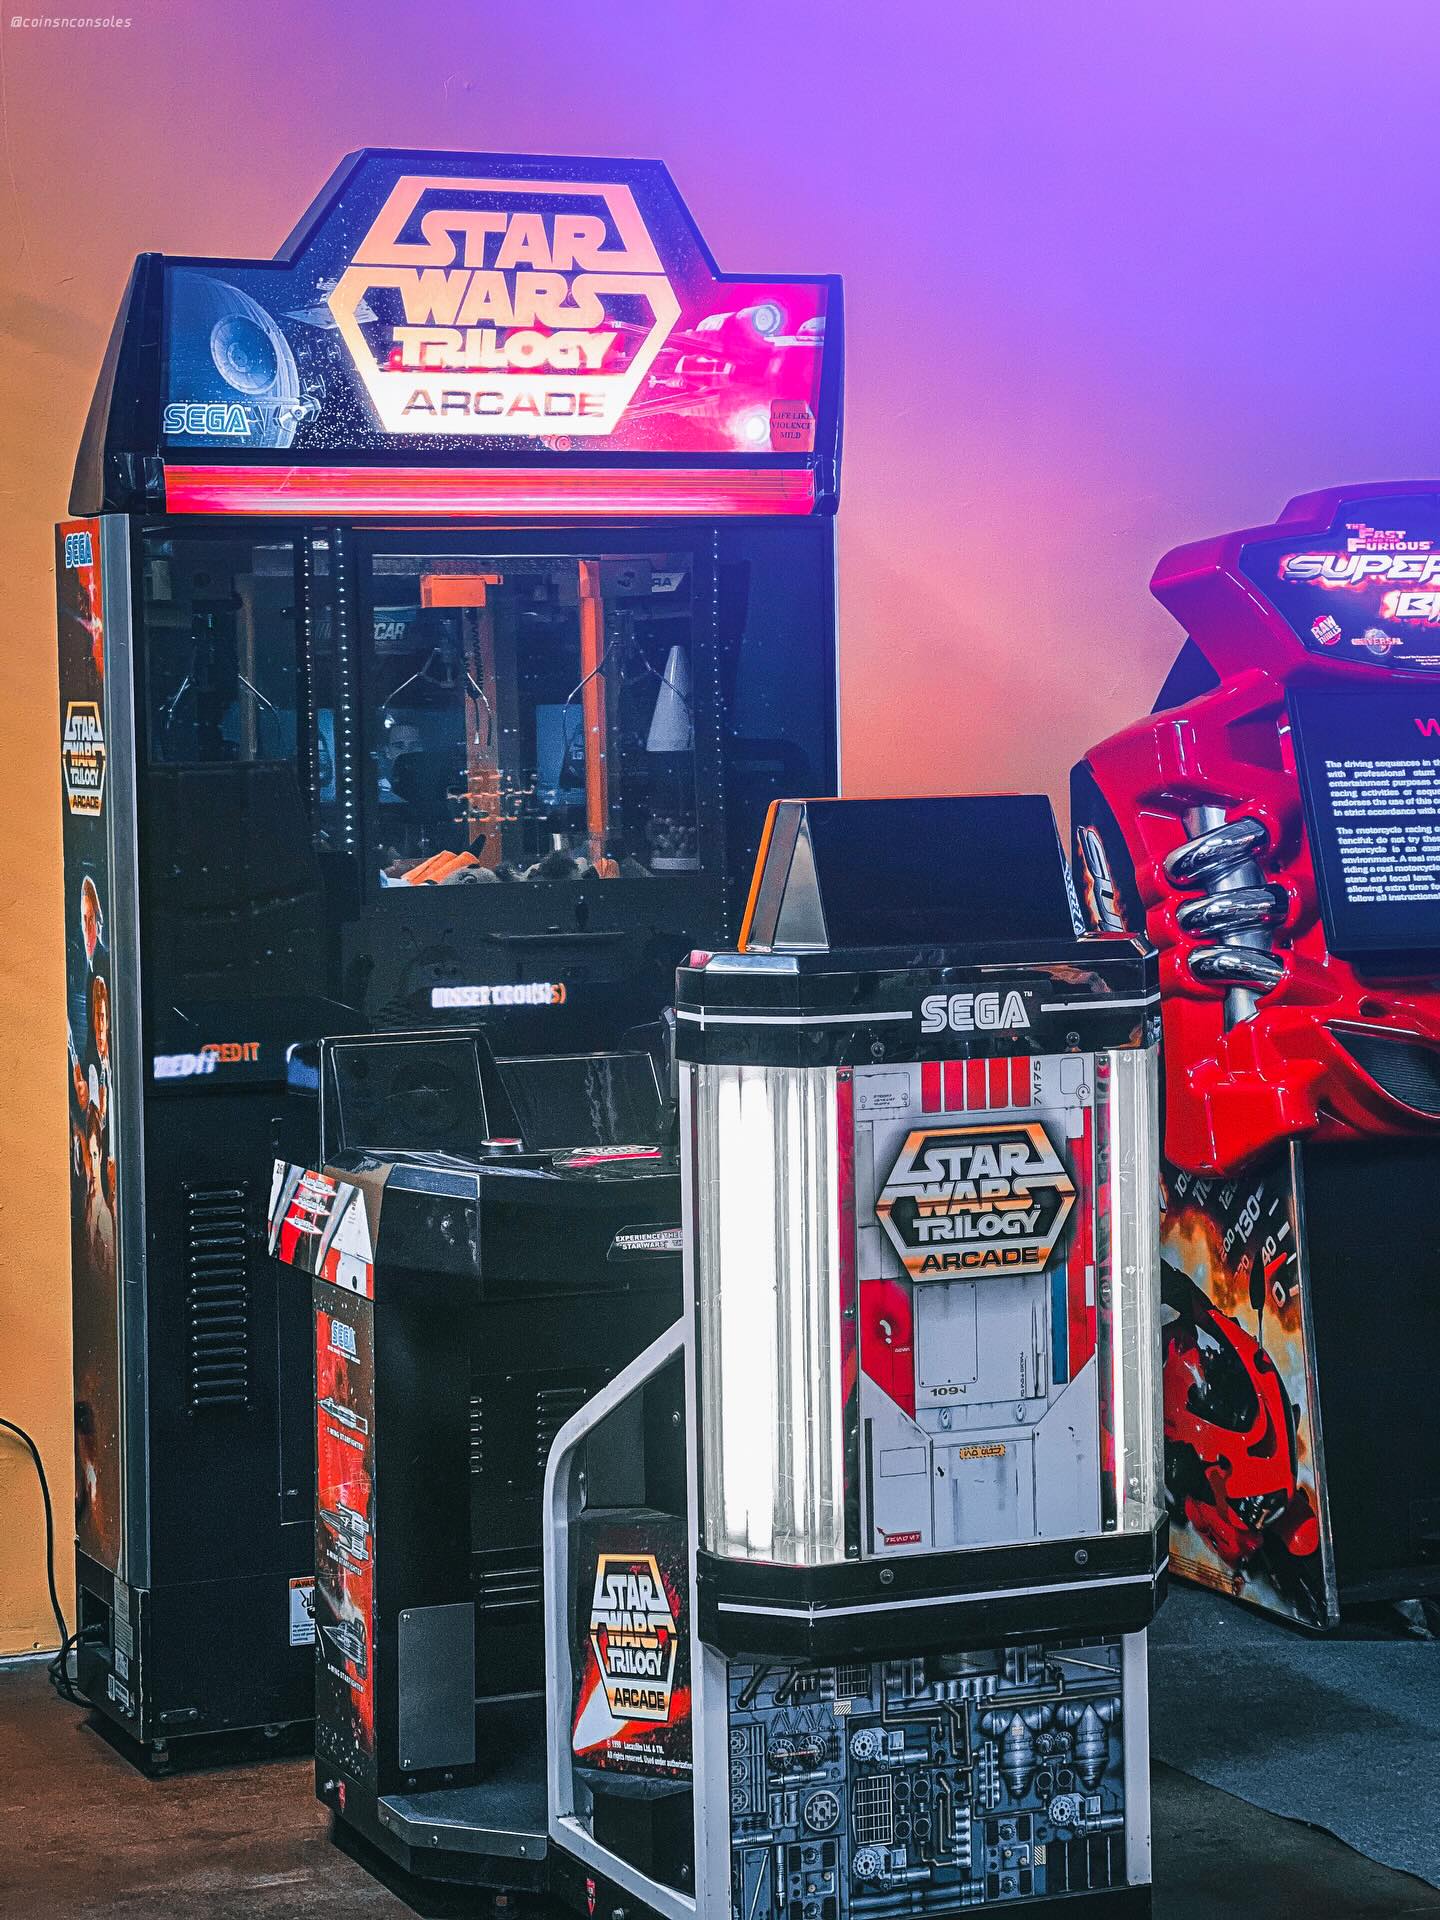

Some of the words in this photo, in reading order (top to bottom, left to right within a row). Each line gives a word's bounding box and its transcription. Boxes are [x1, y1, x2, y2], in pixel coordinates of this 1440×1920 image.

[394, 209, 607, 269] STAR
[400, 268, 607, 329] WARS
[393, 328, 617, 369] TRILOGY
[400, 390, 606, 418] ARCADE
[773, 412, 791, 420] LIFE
[793, 412, 812, 420] LIKE
[163, 403, 251, 435] SEGA
[771, 422, 812, 430] VIOLENCE
[781, 431, 801, 439] MILD
[1347, 538, 1434, 552] FURIOUS
[1359, 527, 1406, 540] FAST
[65, 532, 93, 568] SEGA
[1311, 615, 1337, 638] RAW
[69, 715, 101, 741] STAR
[70, 741, 99, 767] WARS
[1344, 760, 1373, 768] driving
[70, 767, 99, 785] TRILOGY
[1354, 770, 1405, 778] professional
[72, 795, 100, 810] ARCADE
[1330, 790, 1358, 798] racing
[921, 990, 1031, 1033] SEGA
[910, 1142, 1043, 1180] STAR
[915, 1179, 1034, 1217] WARS
[913, 1209, 1041, 1242] TRILOGY
[1235, 1195, 1261, 1243] 130
[615, 1233, 661, 1242] EXPERIENCE
[1261, 1236, 1276, 1266] 40
[920, 1246, 1040, 1273] ARCADE
[1272, 1281, 1286, 1308] 0
[332, 1320, 356, 1355] SEGA
[601, 1574, 661, 1611] STAR
[606, 1611, 663, 1648] WARS
[607, 1649, 663, 1676] TRILOGY
[613, 1687, 666, 1712] ARCADE
